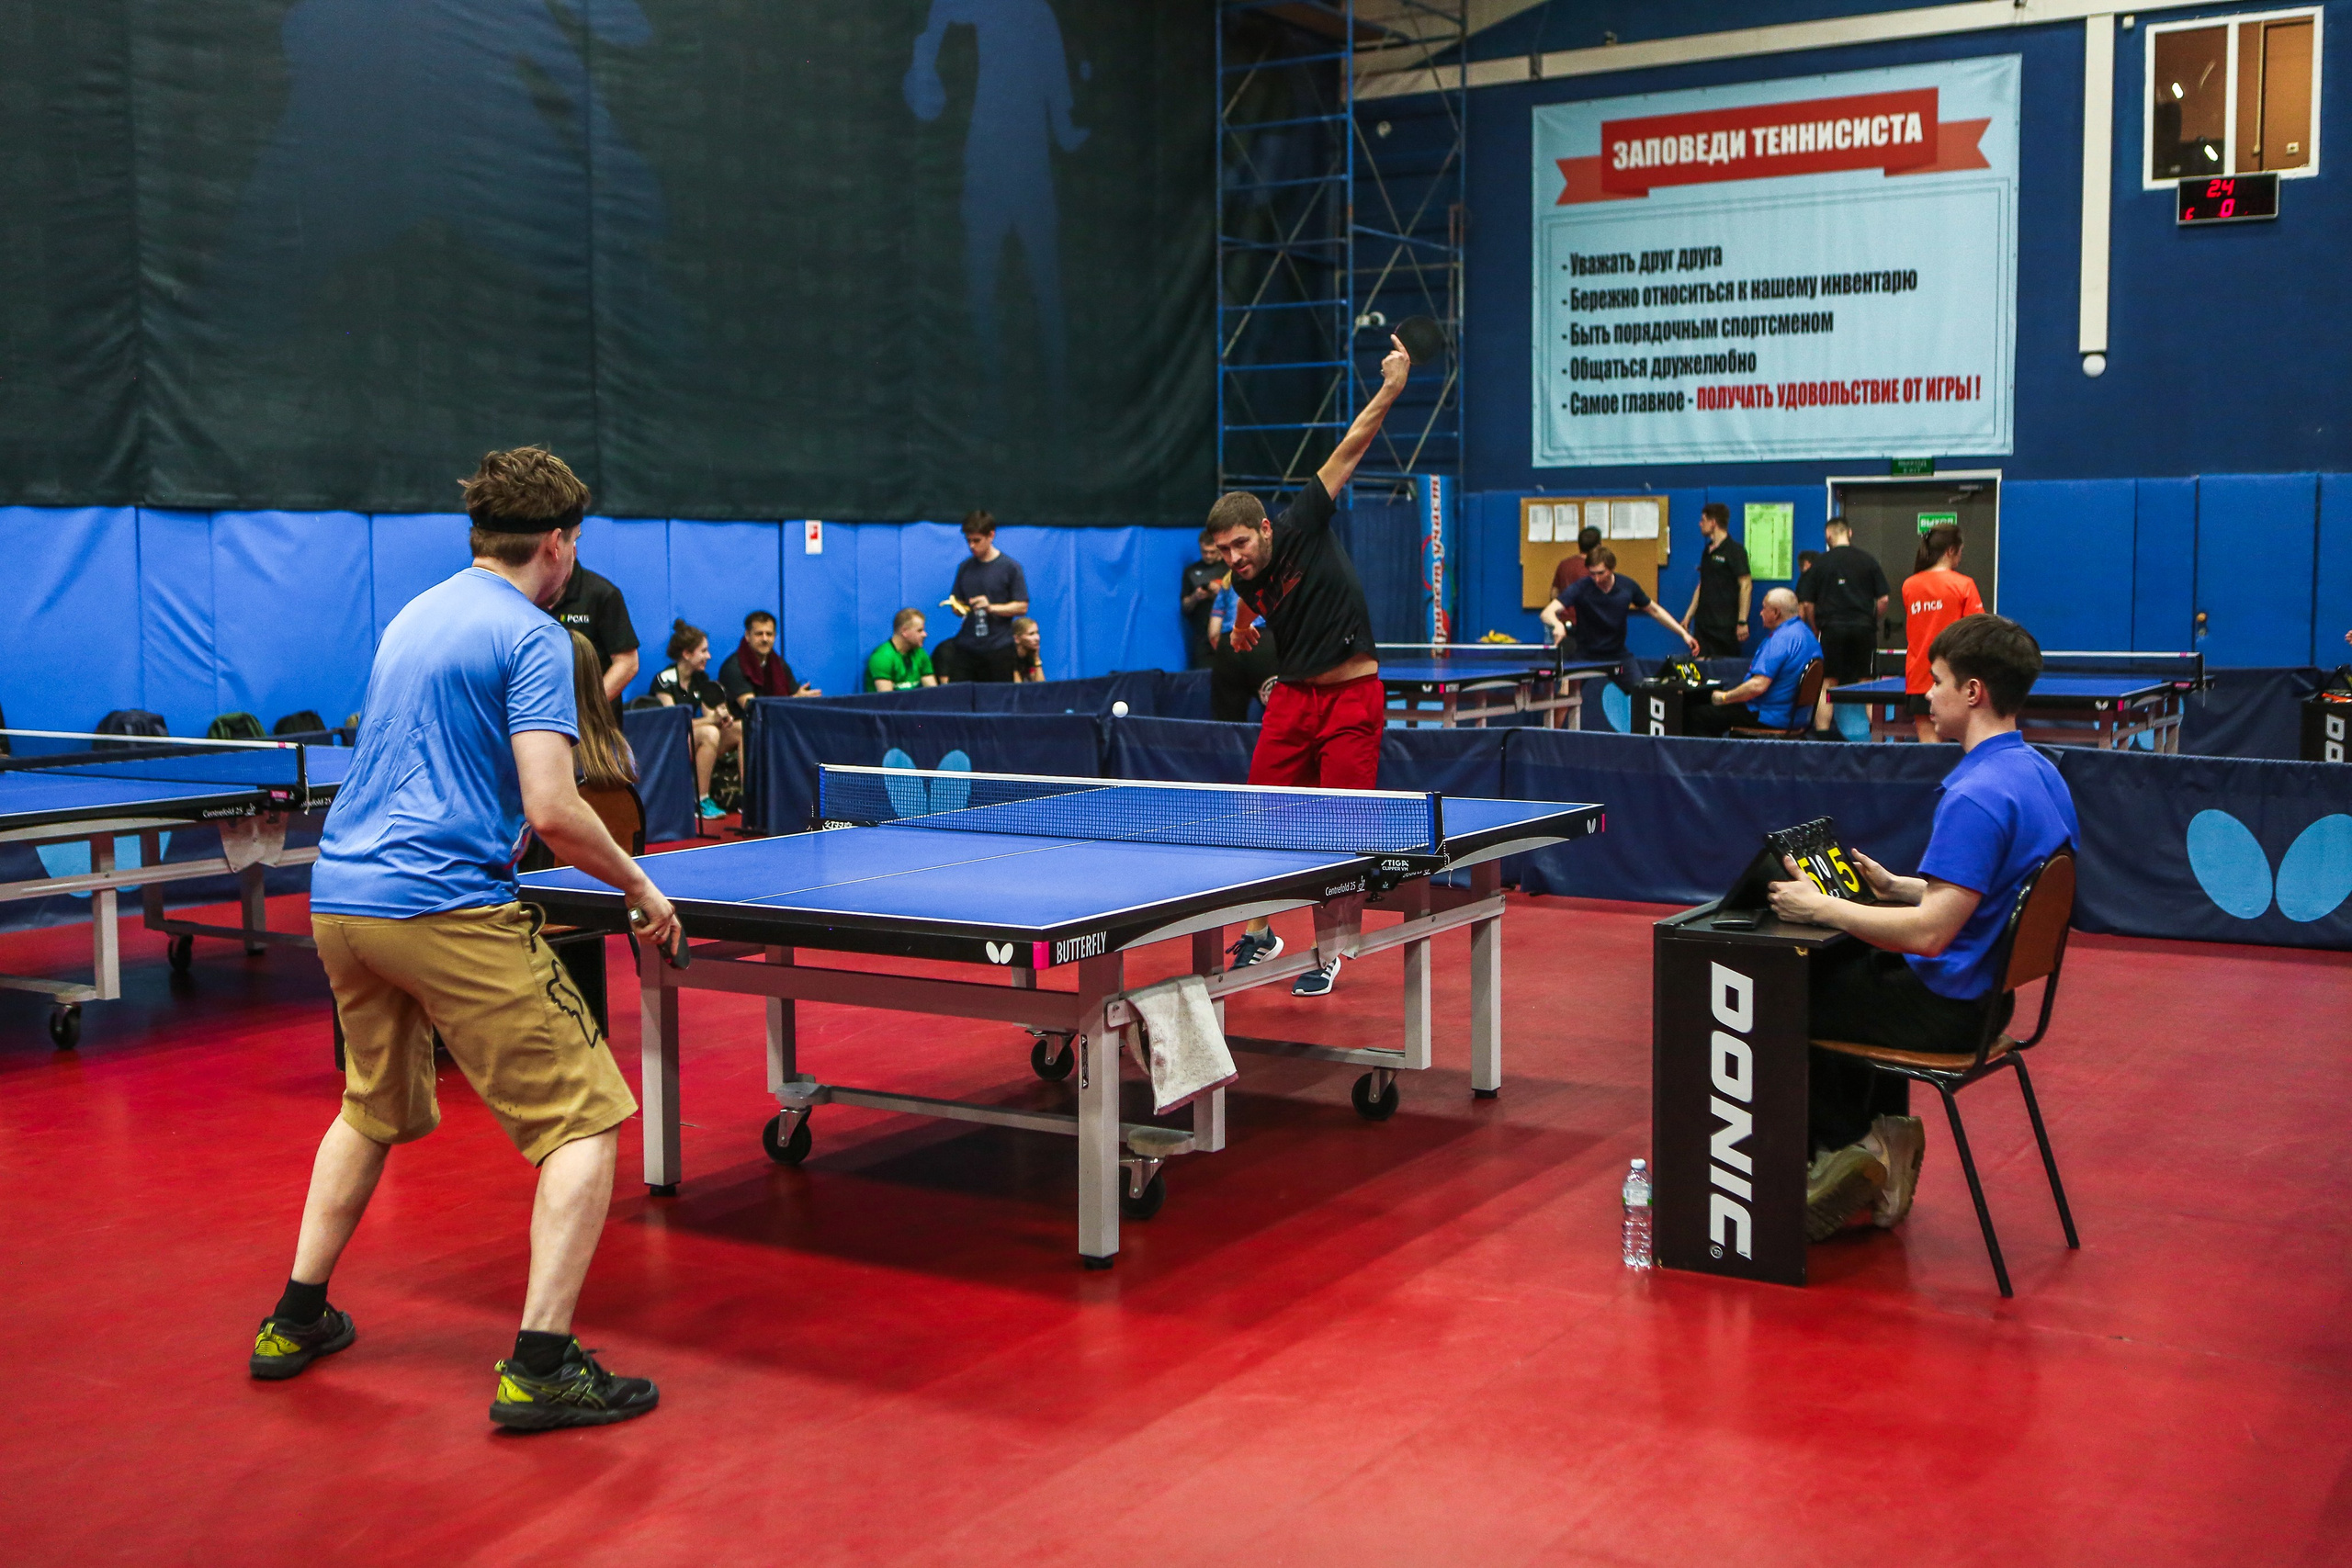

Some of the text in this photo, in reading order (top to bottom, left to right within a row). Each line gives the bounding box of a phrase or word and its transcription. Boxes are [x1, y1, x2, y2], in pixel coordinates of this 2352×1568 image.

[1612, 111, 1923, 171] ЗАПОВЕДИ ТЕННИСИСТА
[1570, 245, 1723, 276] Уважать друг друга
[1570, 268, 1918, 312] Бережно относиться к нашему инвентарю
[1570, 310, 1834, 346] Быть порядочным спортсменом
[1570, 348, 1757, 382] Общаться дружелюбно
[1570, 391, 1619, 416] Самое
[1623, 389, 1684, 413] главное
[1697, 383, 1773, 412] ПОЛУЧАТЬ
[1777, 378, 1899, 412] УДОВОЛЬСТВИЕ
[1903, 377, 1923, 403] ОТ
[1923, 599, 1943, 612] ПСБ
[1826, 847, 1860, 893] 5
[1325, 881, 1356, 897] Centrefold 25
[1056, 931, 1107, 964] BUTTERFLY
[1710, 961, 1754, 1261] DONIC
